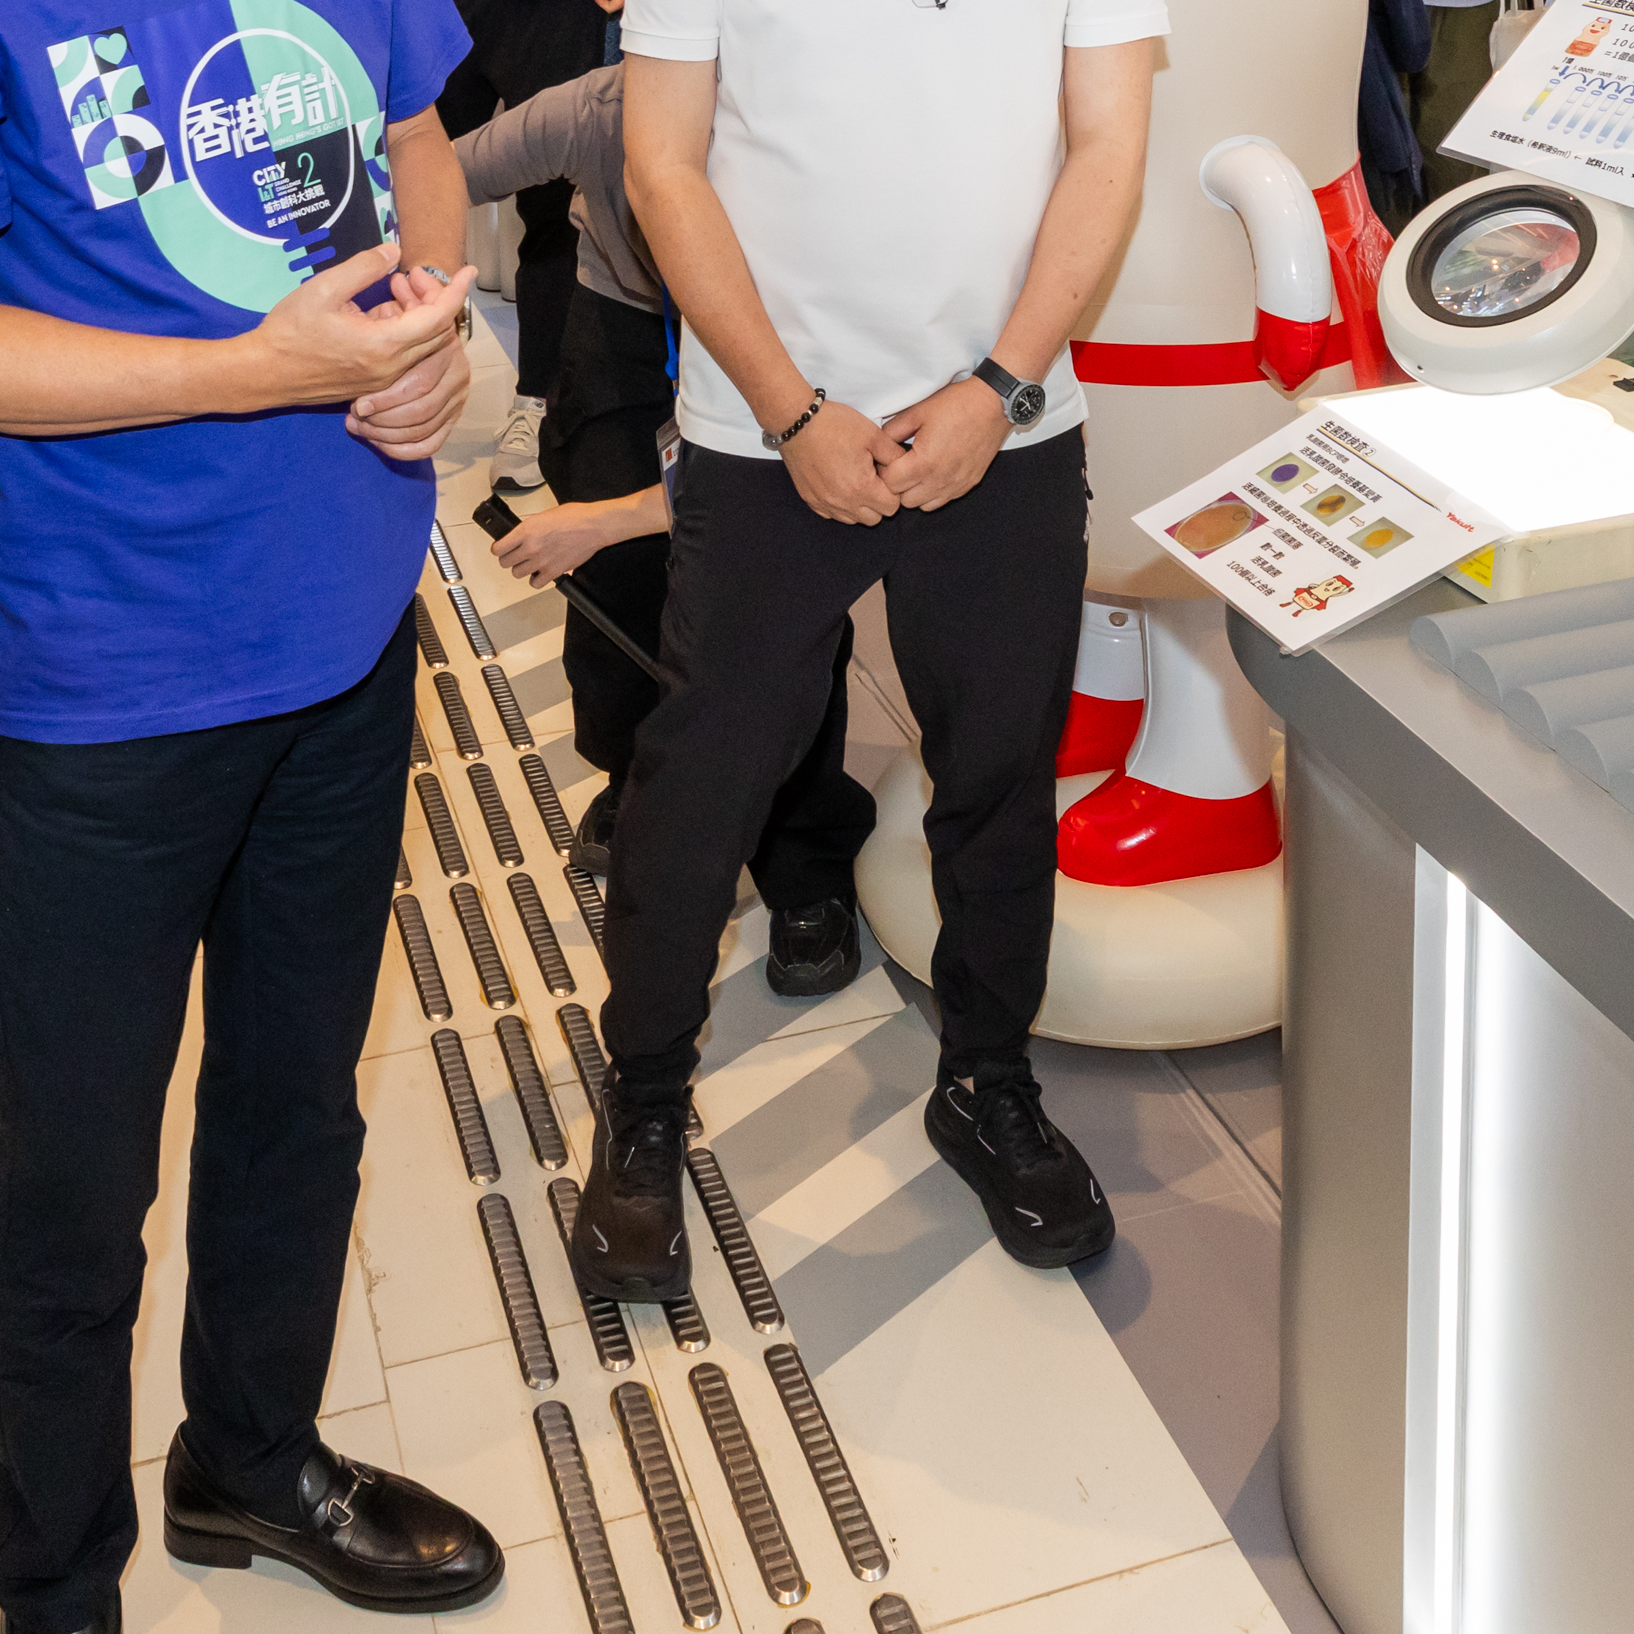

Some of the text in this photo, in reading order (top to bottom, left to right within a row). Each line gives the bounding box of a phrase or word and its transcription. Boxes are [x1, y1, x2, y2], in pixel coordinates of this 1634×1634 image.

[185, 67, 338, 162] 香港有計
[252, 162, 287, 186] CITY
[298, 152, 321, 187] 2
[267, 199, 331, 228] BE AN INNOVATOR
[1446, 511, 1476, 534] Yakult
